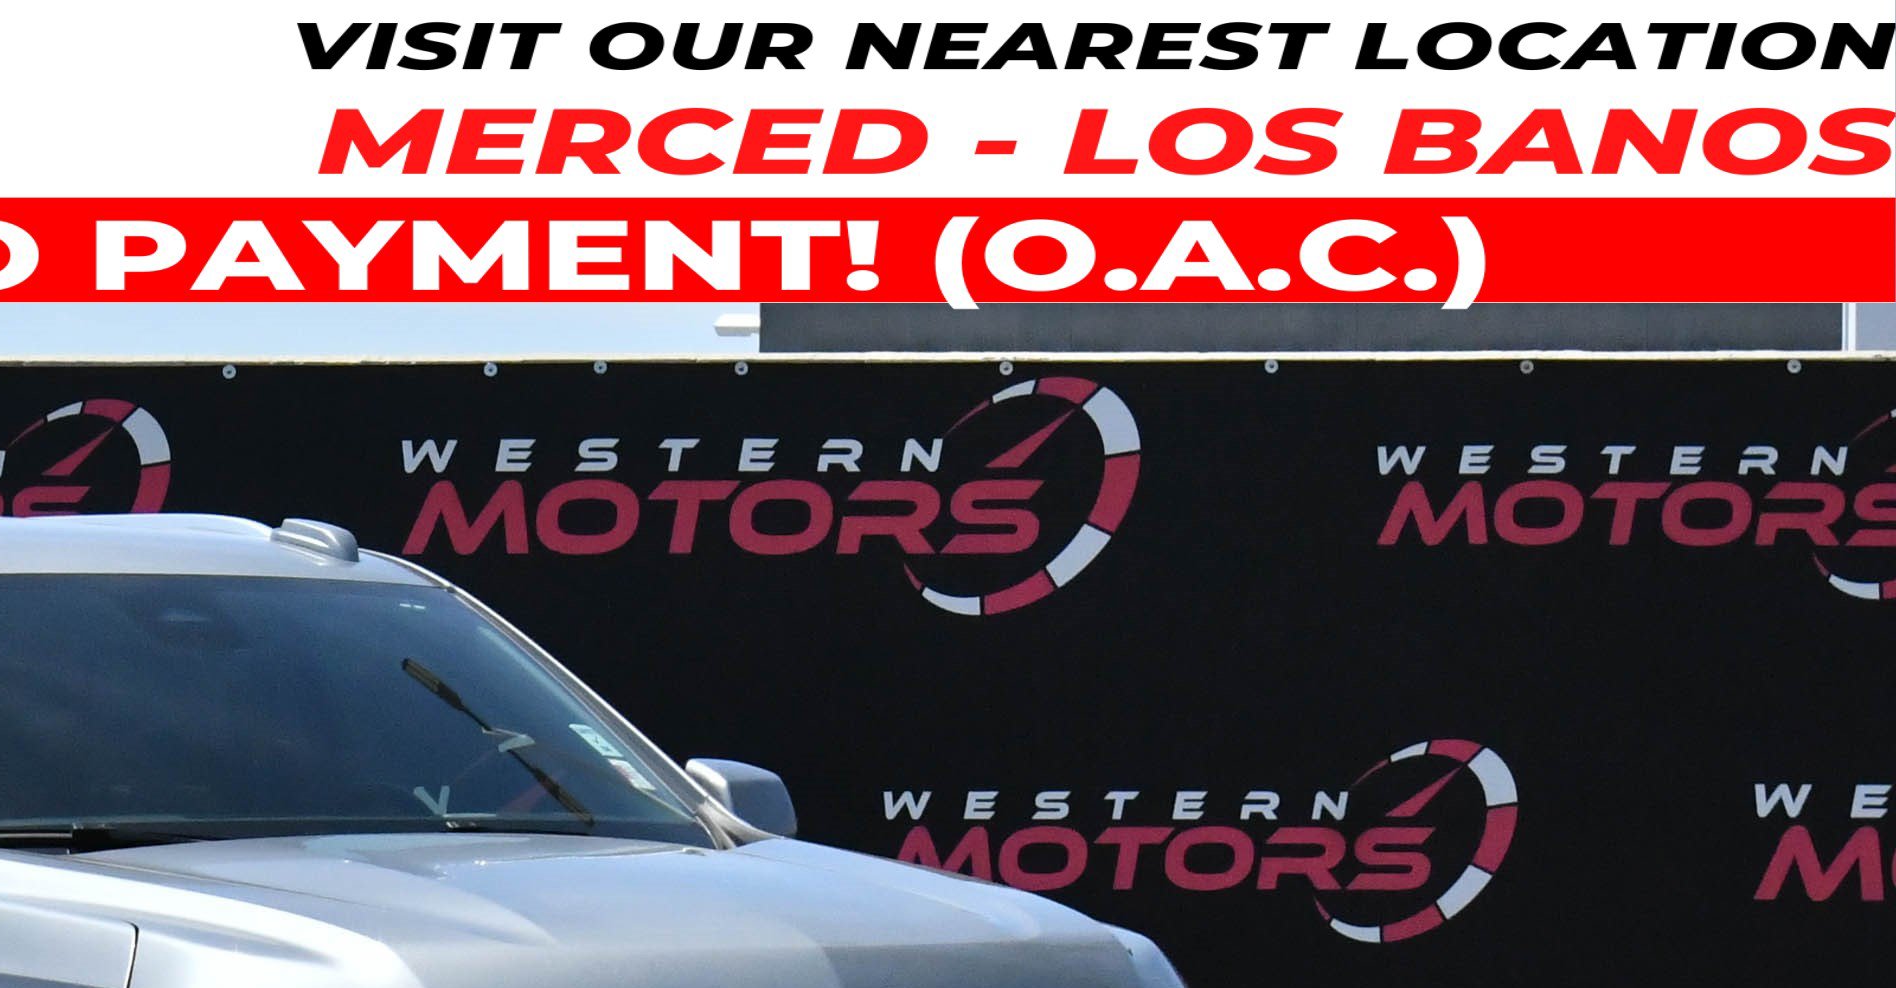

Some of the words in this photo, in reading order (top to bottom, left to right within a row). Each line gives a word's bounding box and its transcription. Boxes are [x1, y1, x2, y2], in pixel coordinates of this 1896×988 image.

[401, 438, 943, 474] WESTERN
[1377, 445, 1848, 476] WESTERN
[404, 479, 1044, 556] MOTORS
[1378, 480, 1896, 547] MOTORS
[883, 790, 1349, 820] WESTERN
[1754, 783, 1894, 818] WE
[897, 825, 1434, 891] MOTORS
